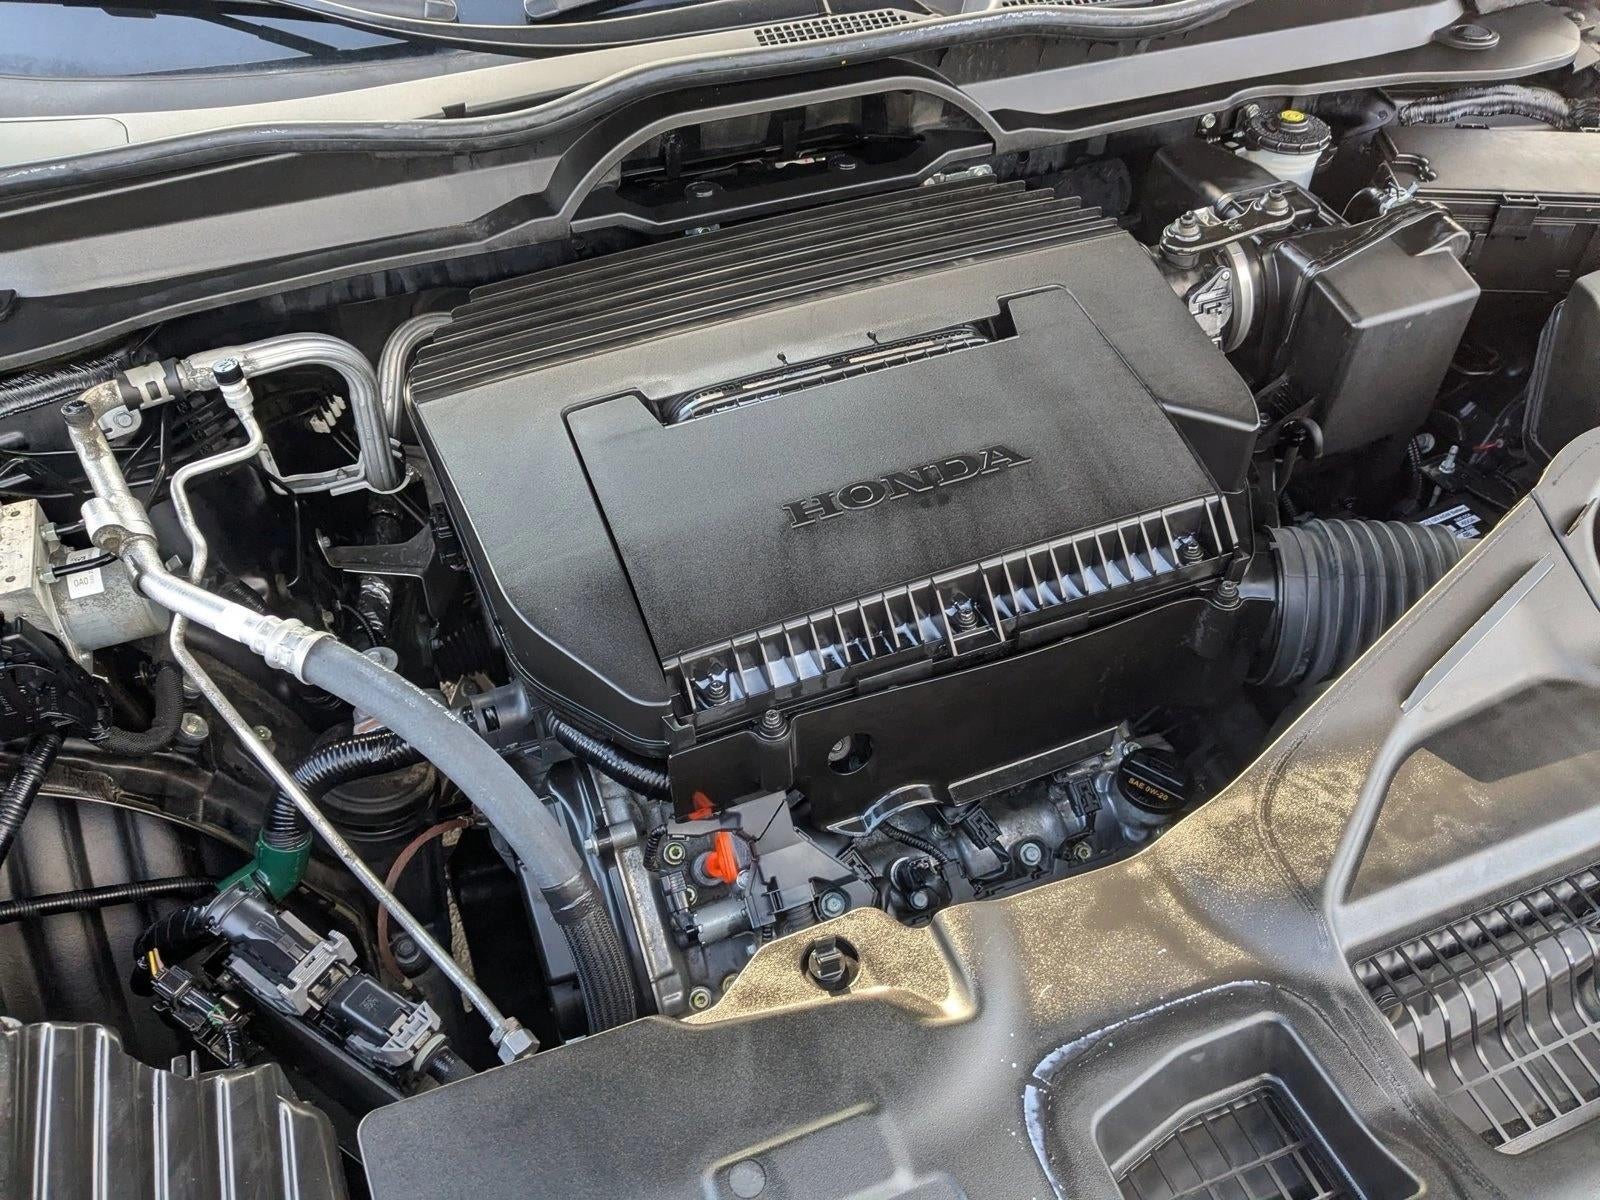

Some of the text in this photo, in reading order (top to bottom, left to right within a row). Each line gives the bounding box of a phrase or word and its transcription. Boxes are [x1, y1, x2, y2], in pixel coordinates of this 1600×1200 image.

[782, 444, 1032, 528] HONDA
[1128, 777, 1169, 801] SAE 0W-20
